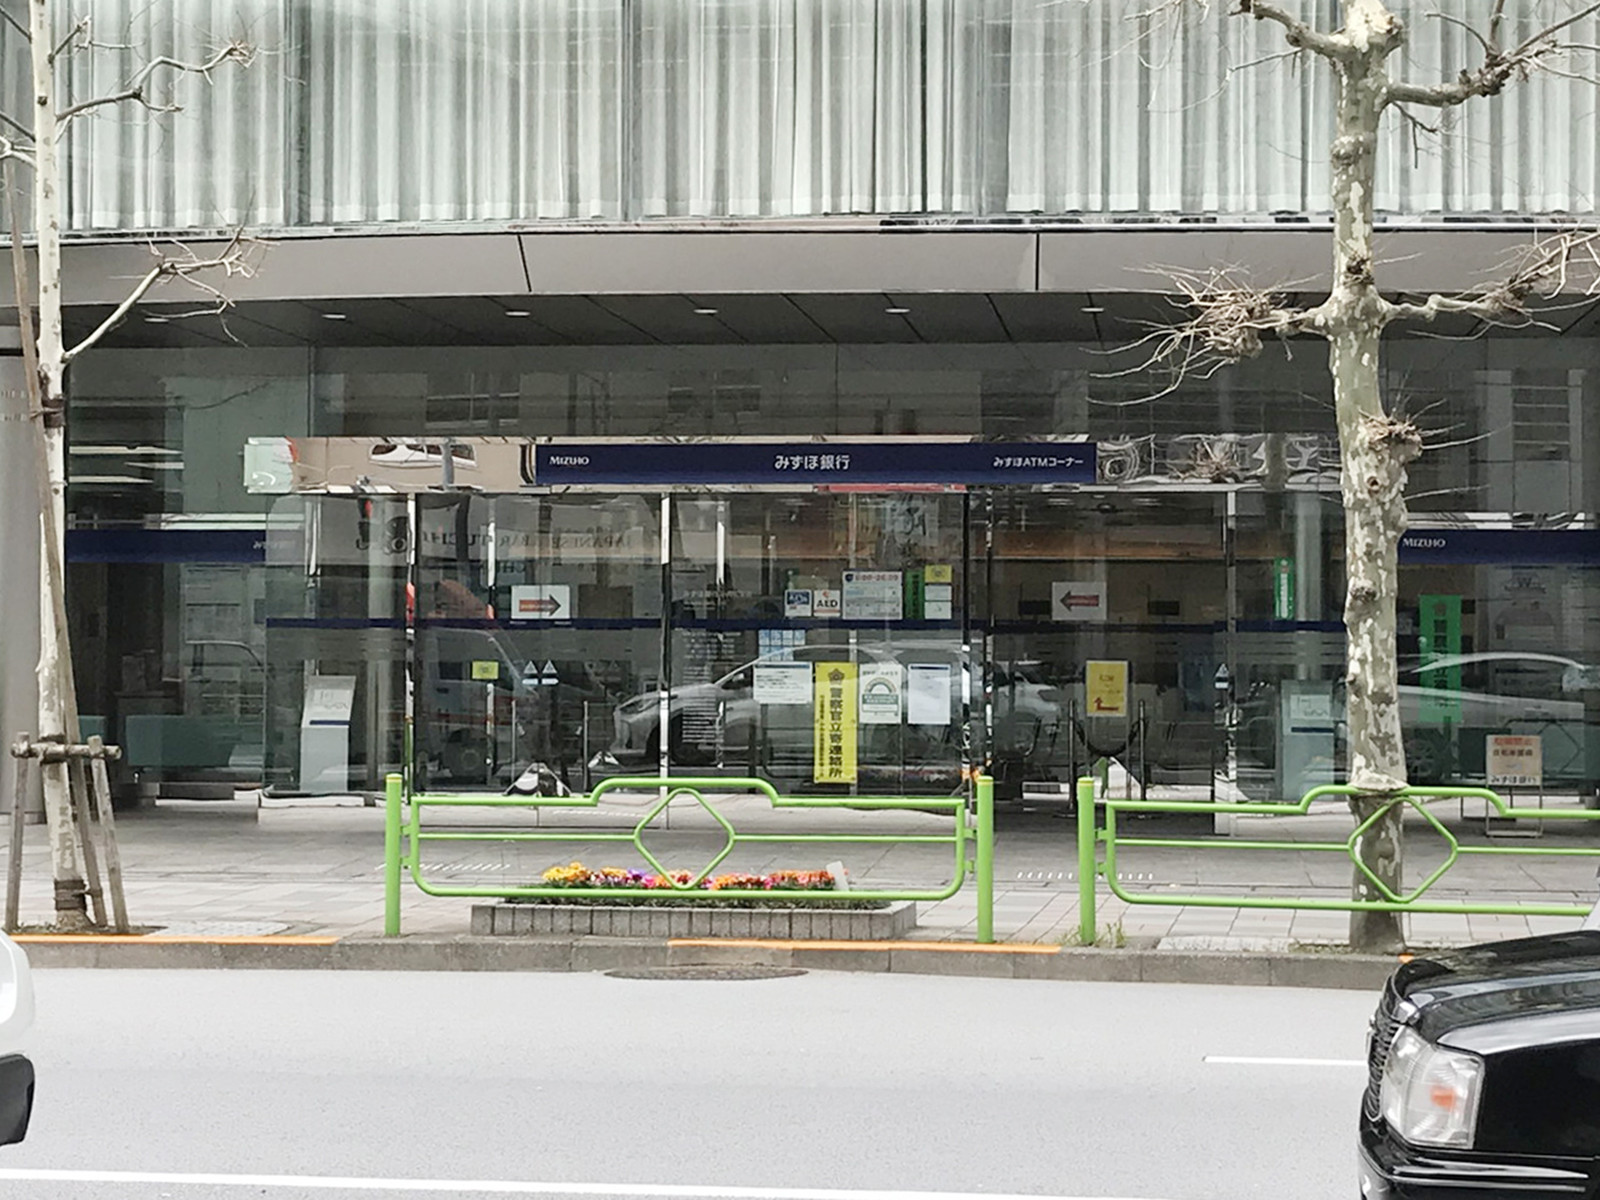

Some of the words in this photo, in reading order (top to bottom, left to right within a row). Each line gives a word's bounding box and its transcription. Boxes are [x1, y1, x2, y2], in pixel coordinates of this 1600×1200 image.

[549, 456, 590, 465] MIZUHO
[774, 454, 851, 470] みずほ銀行
[993, 456, 1084, 468] みずほATMコーナー
[1402, 537, 1446, 548] MIZUHO
[816, 599, 839, 608] AED
